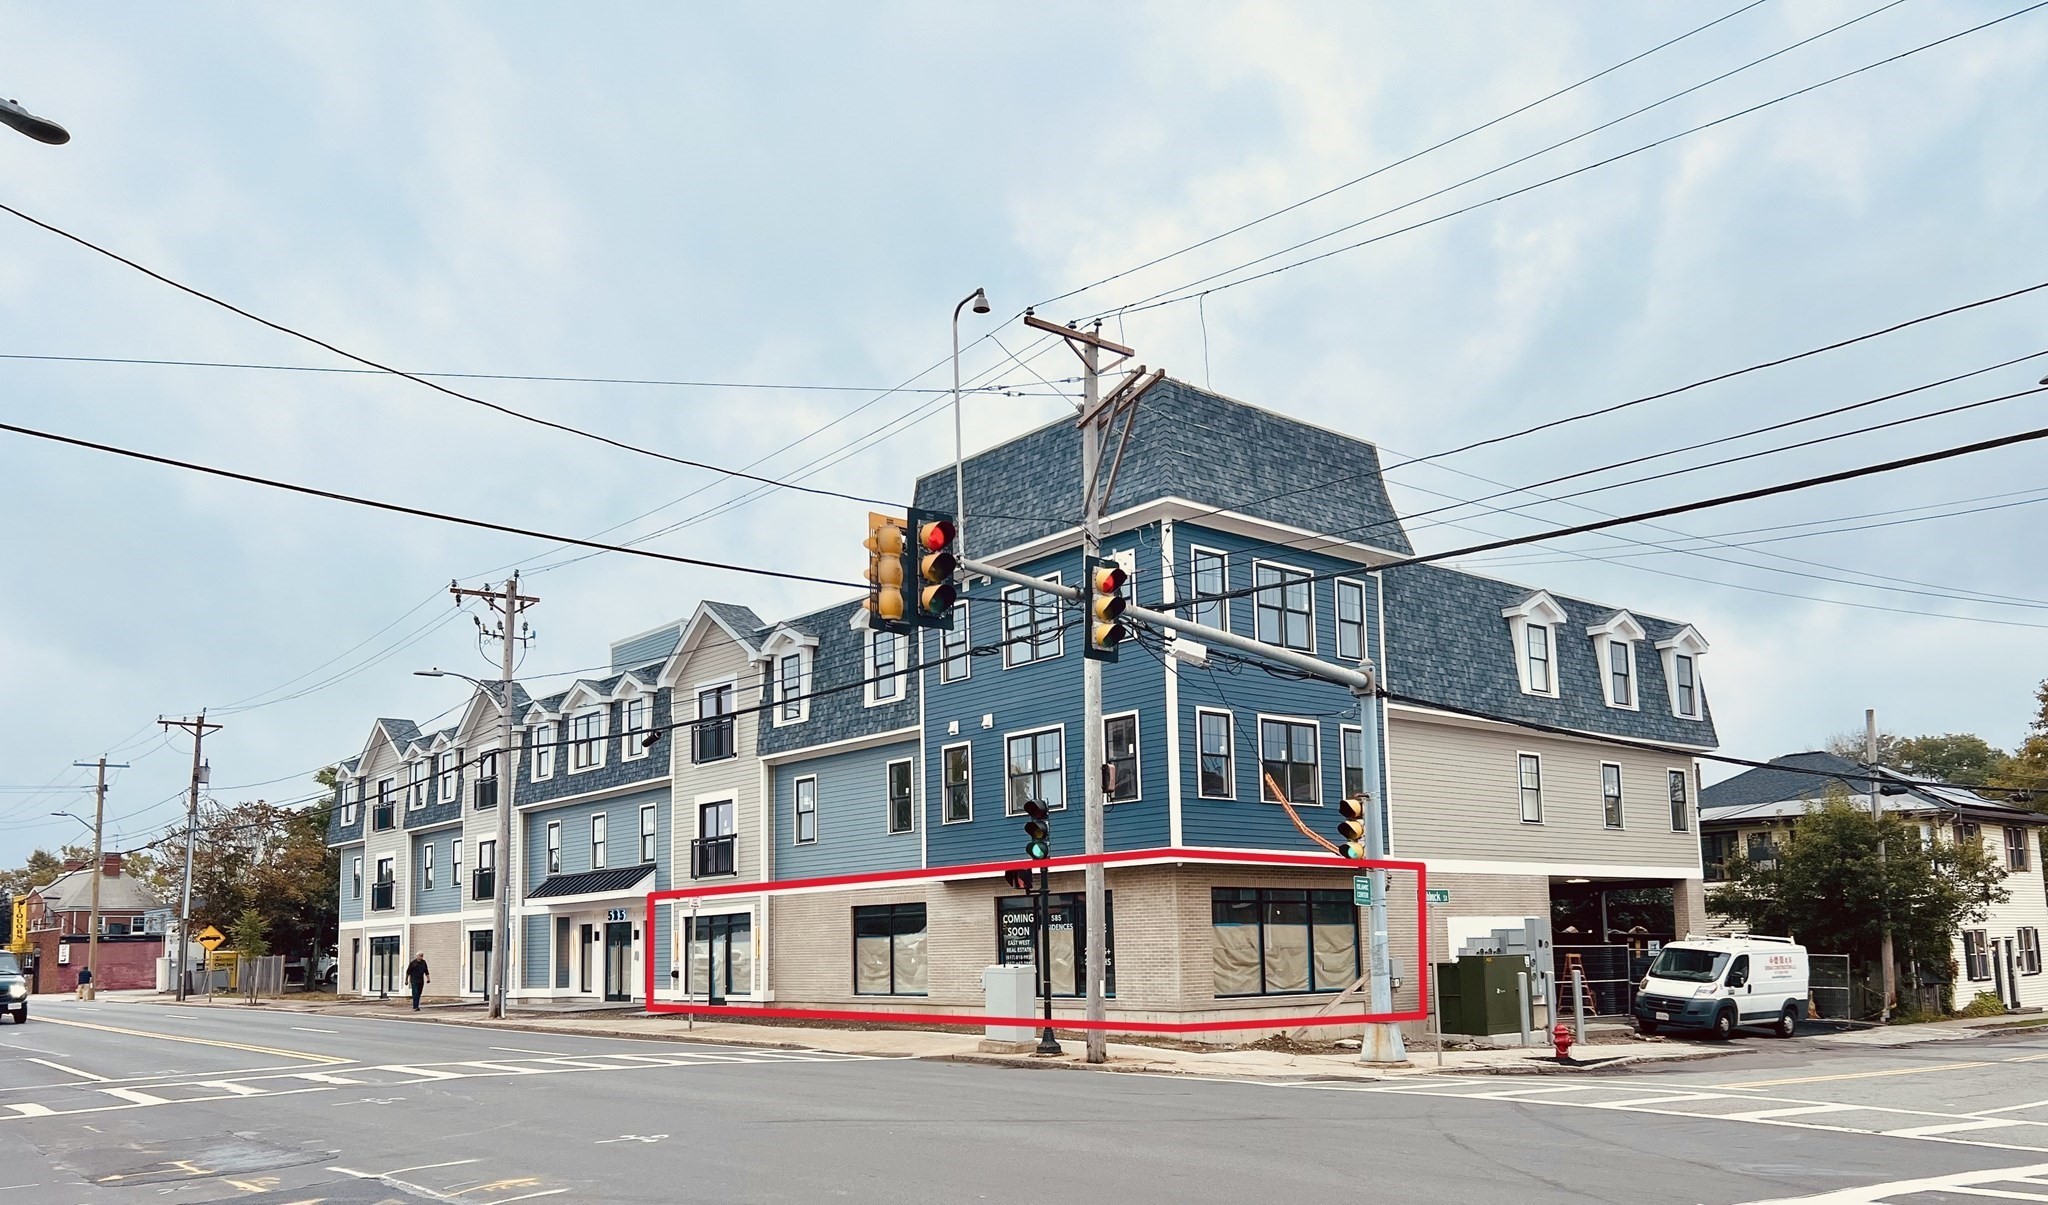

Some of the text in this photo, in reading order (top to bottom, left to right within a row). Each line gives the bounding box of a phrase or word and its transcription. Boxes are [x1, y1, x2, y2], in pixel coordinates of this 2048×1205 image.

[608, 910, 626, 921] 585
[1003, 914, 1034, 924] COMING
[1008, 927, 1030, 936] SOON
